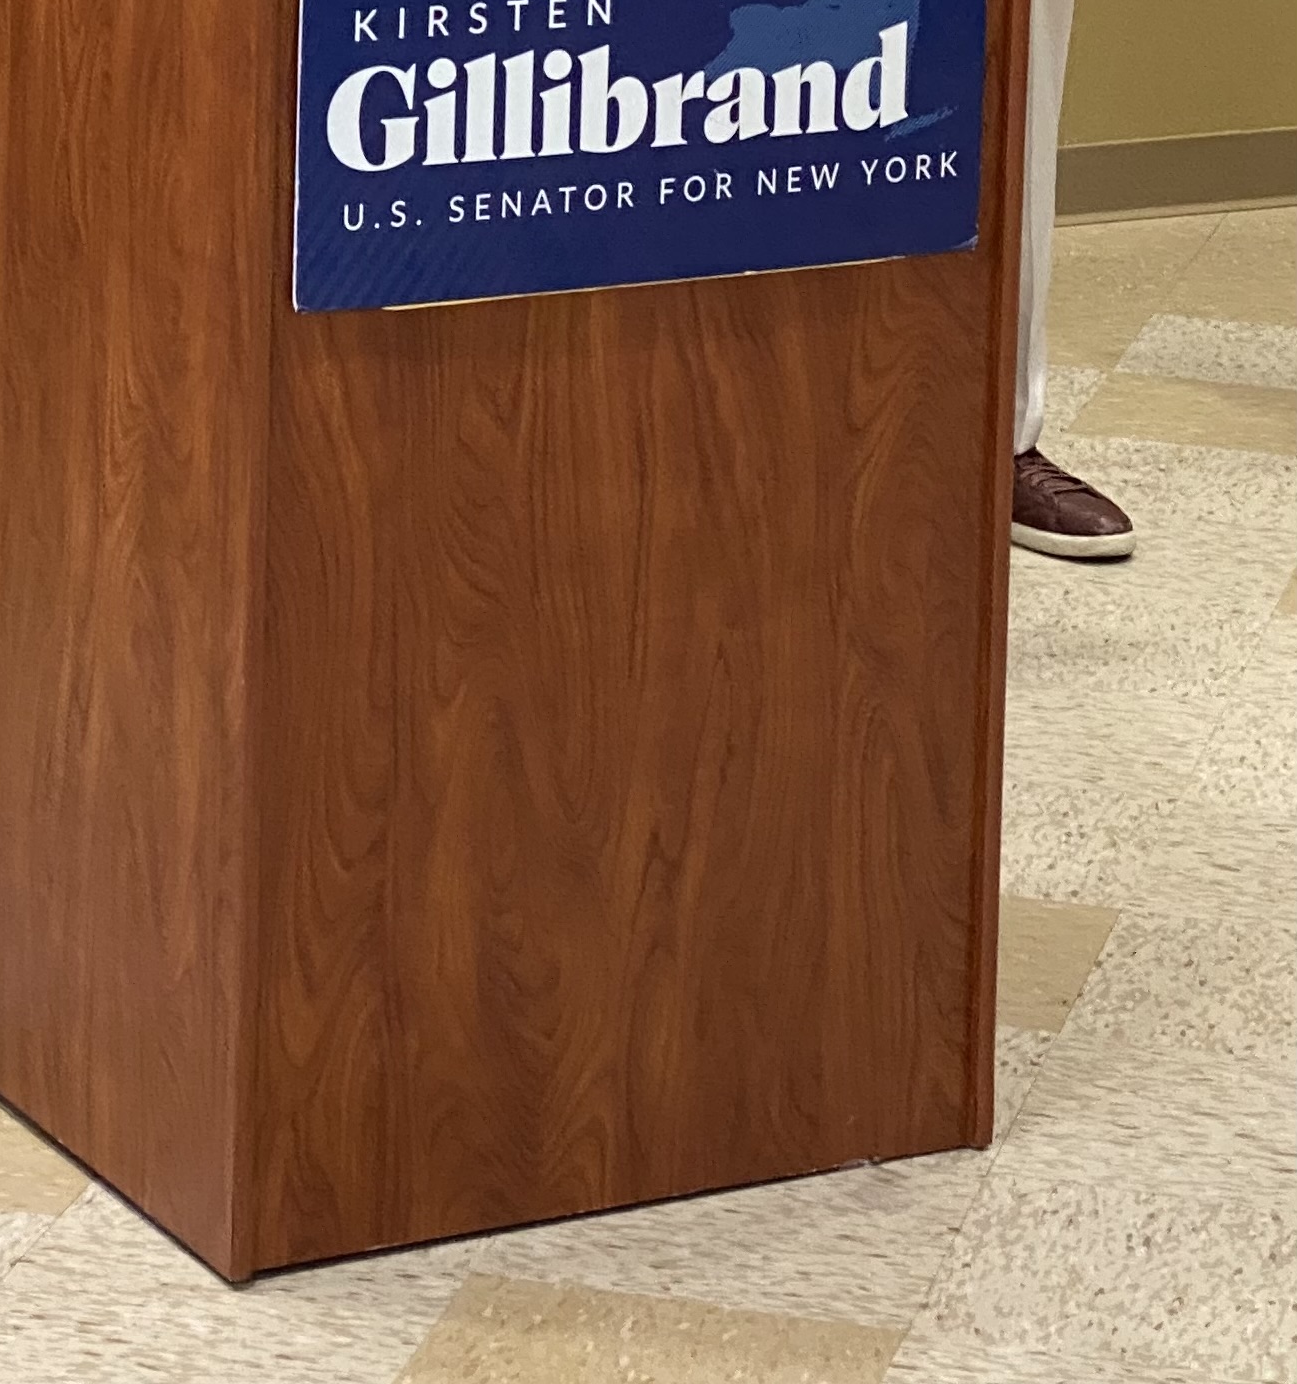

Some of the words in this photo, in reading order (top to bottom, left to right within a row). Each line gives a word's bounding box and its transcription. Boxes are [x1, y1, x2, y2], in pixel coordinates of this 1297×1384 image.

[326, 20, 909, 173] Gillibrand
[343, 200, 423, 232] U.S.
[449, 182, 635, 223] SENATOR
[660, 172, 734, 205] FOR
[757, 162, 841, 195] NEW
[862, 151, 959, 185] YORK
